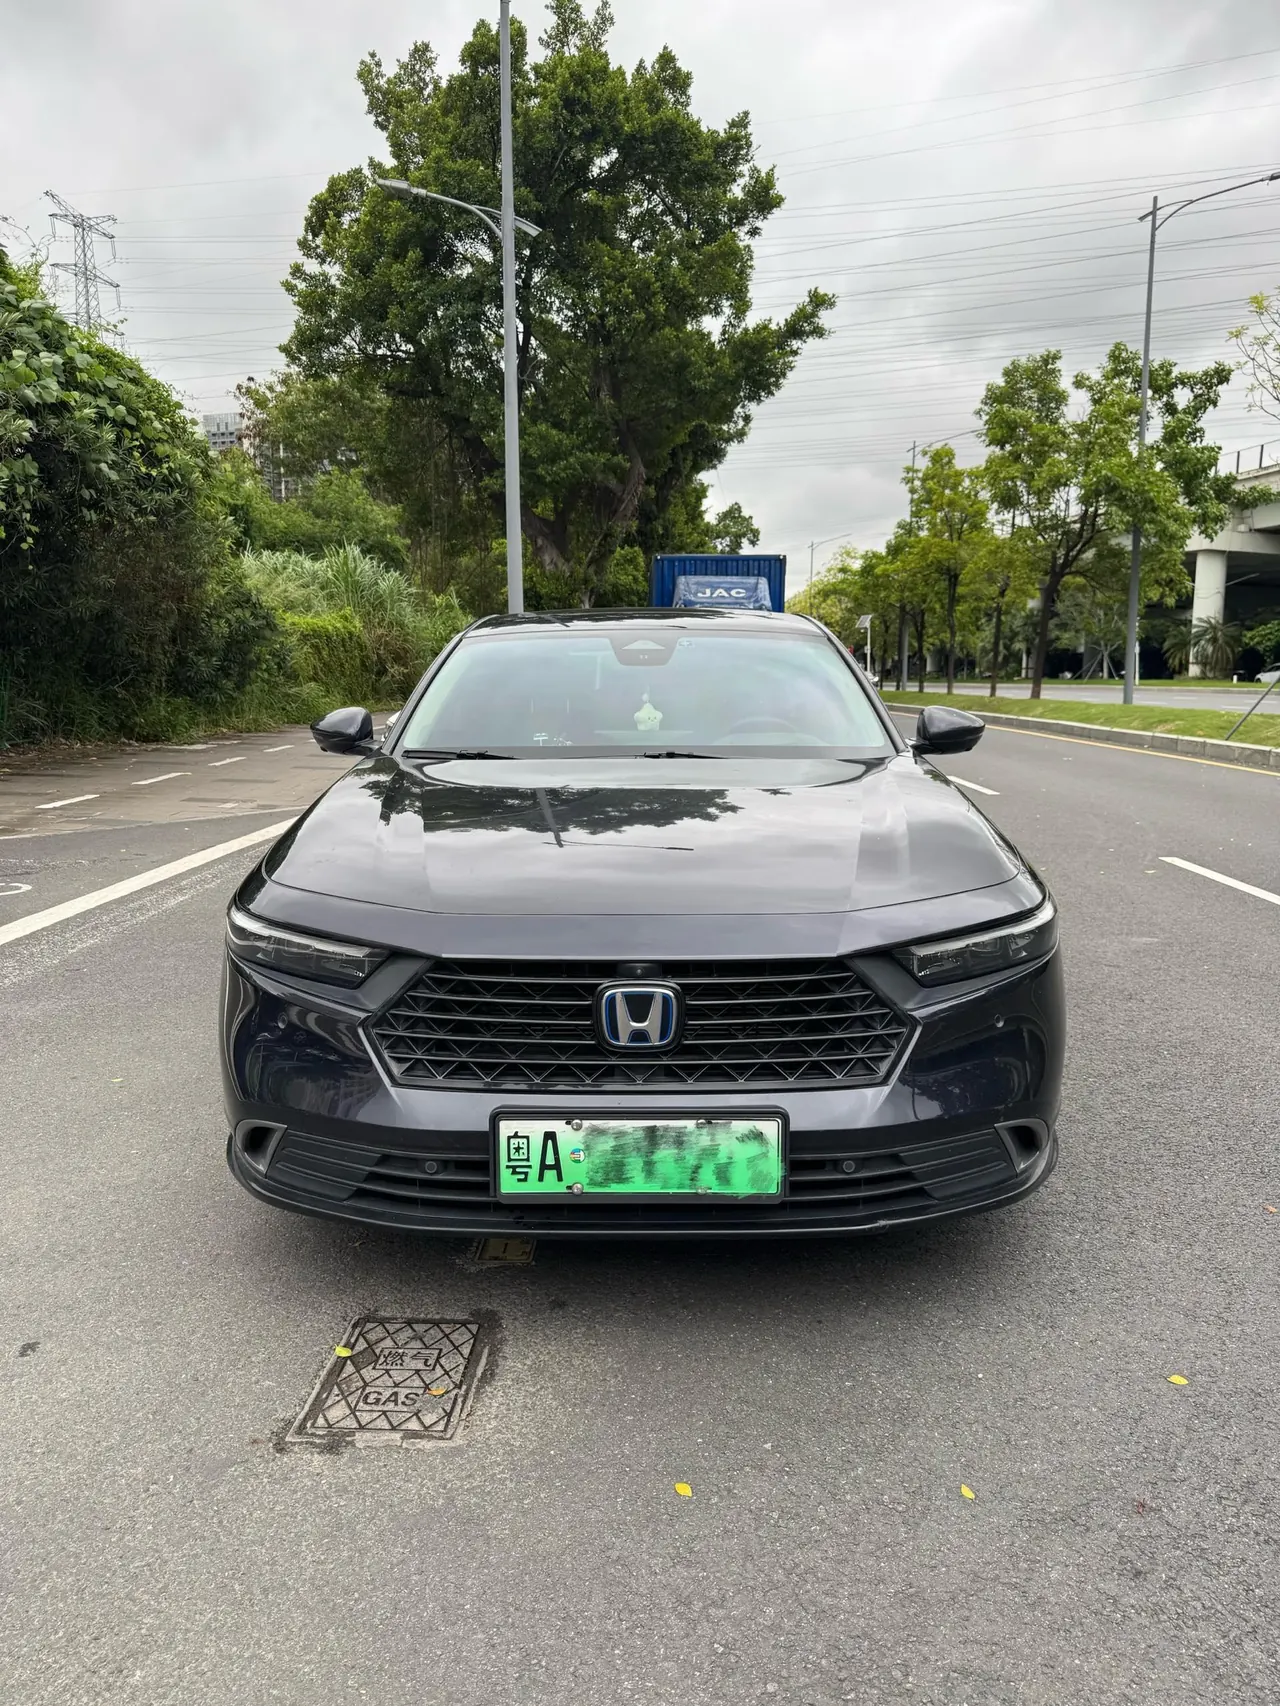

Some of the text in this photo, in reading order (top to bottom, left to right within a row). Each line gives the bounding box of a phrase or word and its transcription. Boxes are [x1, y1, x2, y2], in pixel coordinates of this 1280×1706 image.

[697, 588, 746, 598] JAC
[378, 1350, 434, 1367] 燃气
[362, 1391, 420, 1406] GAS
